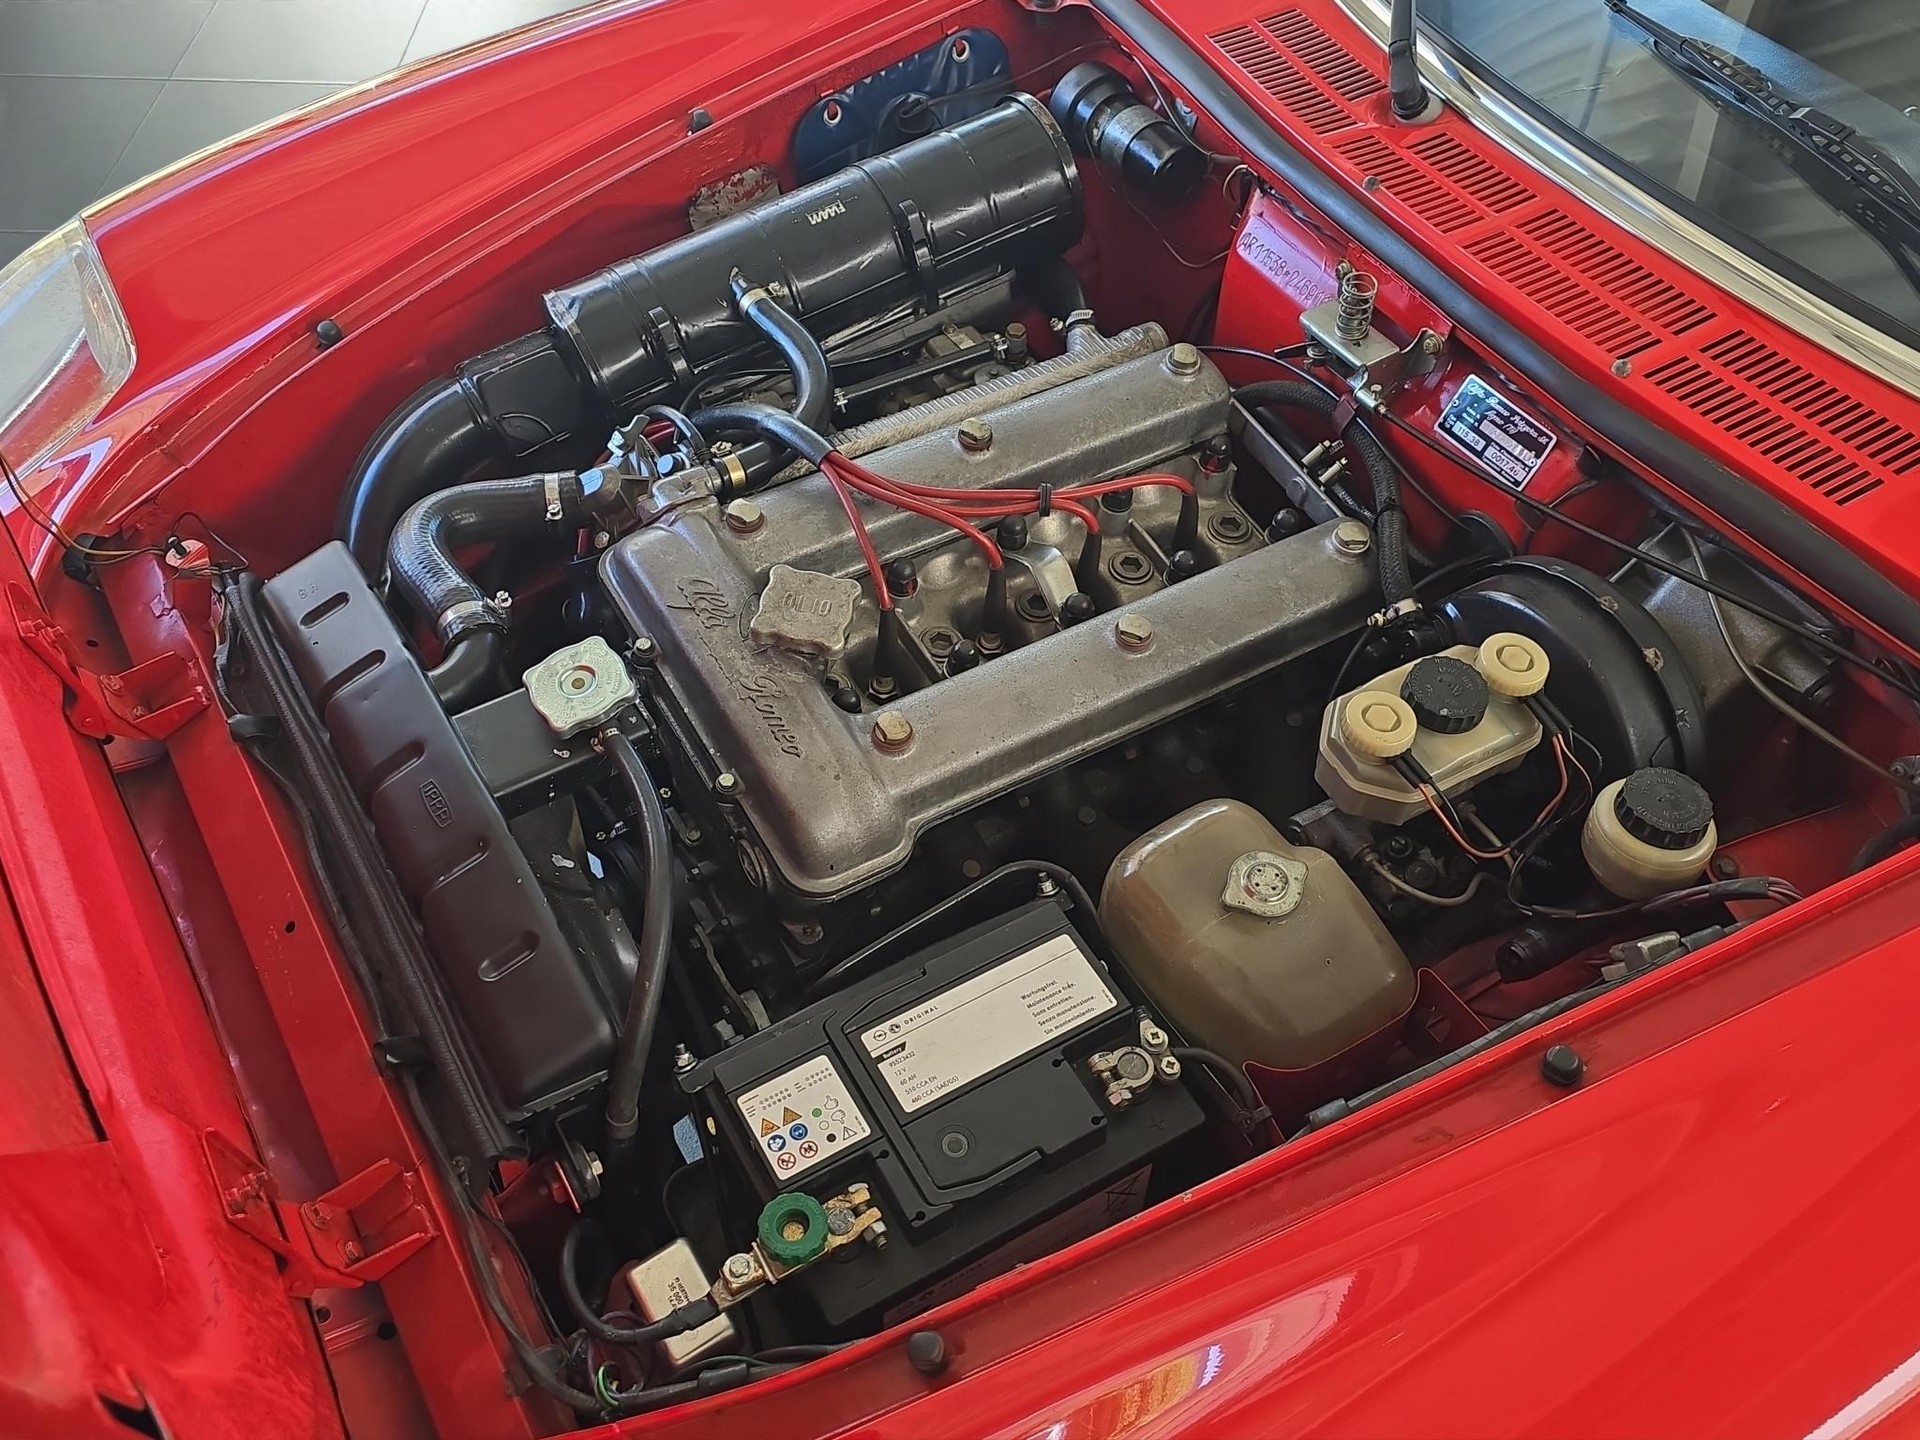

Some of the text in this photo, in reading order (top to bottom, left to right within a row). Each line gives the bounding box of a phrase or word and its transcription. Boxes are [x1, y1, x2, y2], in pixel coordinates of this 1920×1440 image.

[1468, 383, 1485, 399] Alfa
[1486, 396, 1510, 417] Romeo
[1457, 426, 1481, 447] 115.38
[782, 591, 833, 618] OLIO
[666, 576, 803, 758] Alfa Romeo
[1026, 989, 1063, 1010] Maintenance
[903, 1005, 939, 1026] ORIGINAL
[1031, 1008, 1046, 1018] Sans
[1037, 1015, 1056, 1027] Senza
[1043, 1027, 1054, 1036] Sin
[882, 1046, 903, 1060] Battery
[888, 1050, 916, 1068] 95523432
[894, 1068, 902, 1077] 12
[899, 1073, 917, 1087] 60 AH
[904, 1074, 938, 1096] 510 CCA EN
[921, 1087, 935, 1099] CCA
[667, 1282, 685, 1306] 35 000
